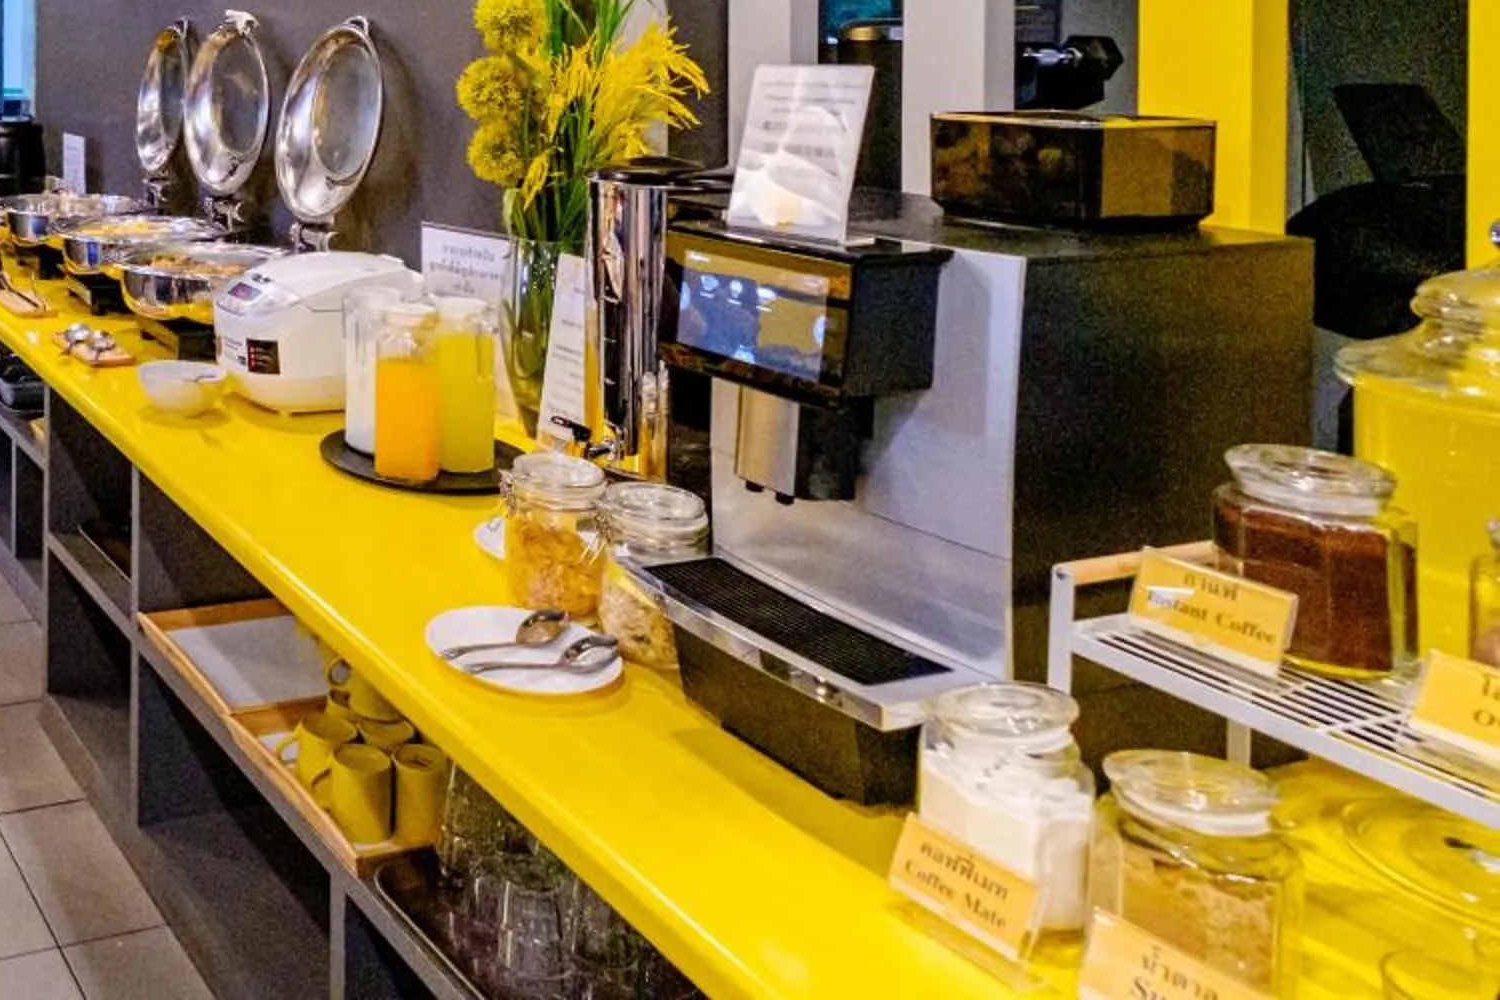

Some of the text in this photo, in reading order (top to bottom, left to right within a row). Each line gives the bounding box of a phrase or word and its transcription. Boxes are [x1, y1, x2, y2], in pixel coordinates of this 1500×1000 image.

[1215, 611, 1277, 644] Coffee
[904, 859, 1007, 928] Coffee Mate
